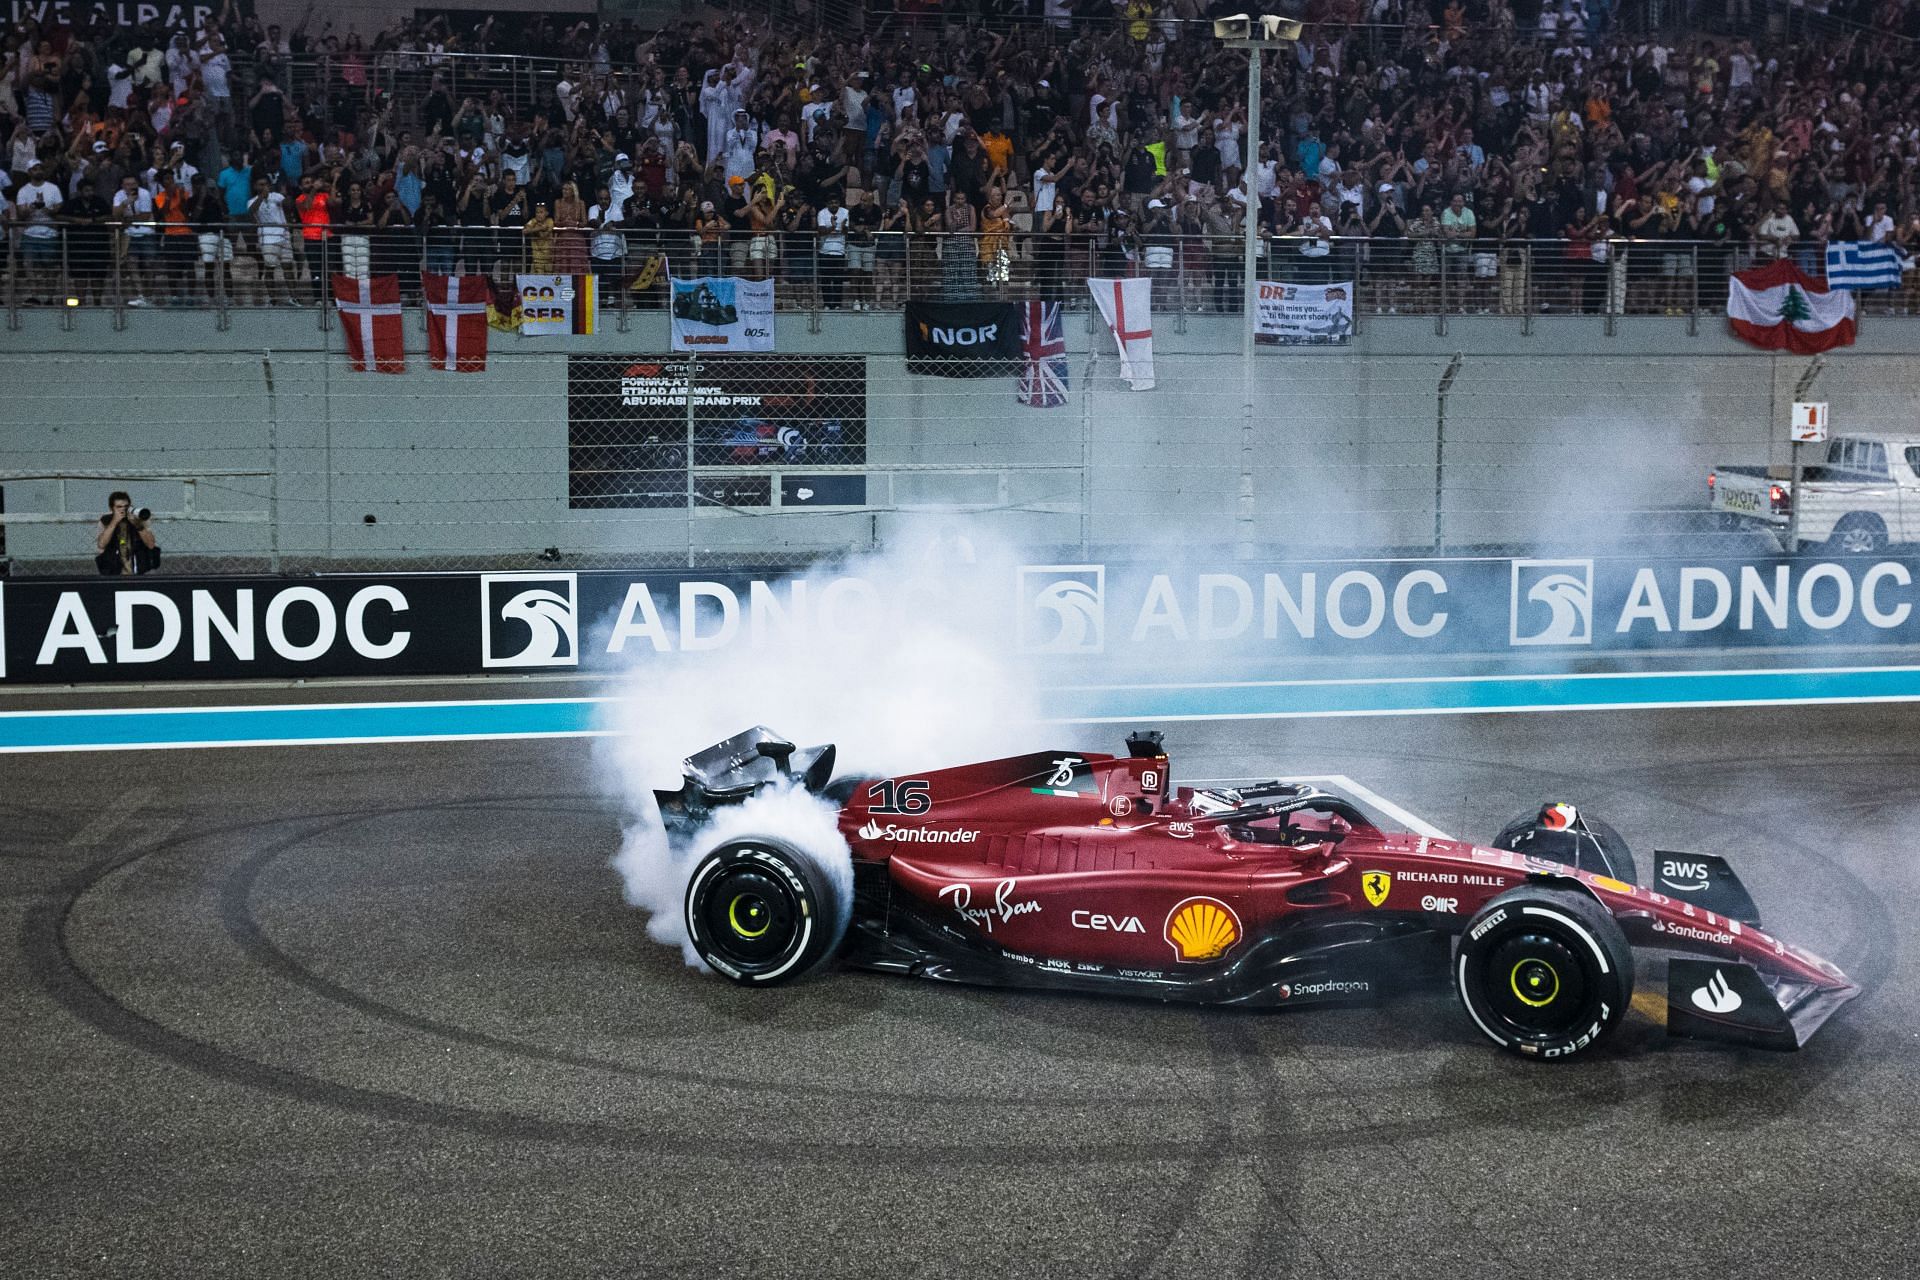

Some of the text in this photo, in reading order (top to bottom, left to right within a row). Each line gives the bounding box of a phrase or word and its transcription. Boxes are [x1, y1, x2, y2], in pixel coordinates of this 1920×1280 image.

[523, 286, 555, 301] GO
[524, 308, 565, 322] SEB
[1278, 311, 1290, 319] the
[1291, 312, 1307, 320] next
[1286, 304, 1303, 312] miss
[932, 323, 998, 346] NOR
[622, 378, 681, 386] FORMULA
[622, 387, 667, 395] ETIHAD
[622, 397, 648, 405] ABU
[649, 397, 687, 405] DHABI
[733, 397, 761, 405] PRIX
[1721, 488, 1760, 506] TOYOTA
[1131, 569, 1449, 641] ADNOC
[1615, 562, 1913, 633] ADNOC
[36, 585, 411, 665] ADNOC
[868, 779, 931, 816] 16
[884, 824, 981, 843] Santander
[1169, 821, 1194, 833] aws
[1663, 861, 1708, 880] aws
[1397, 871, 1504, 887] RICHARD MILLE
[1470, 909, 1508, 941] PIRELLI
[1667, 922, 1735, 945] Santander
[1002, 950, 1034, 964] brembo
[1047, 959, 1071, 969] NGK
[1294, 980, 1369, 995] Snapdragon
[1545, 1002, 1610, 1058] P ZERO
